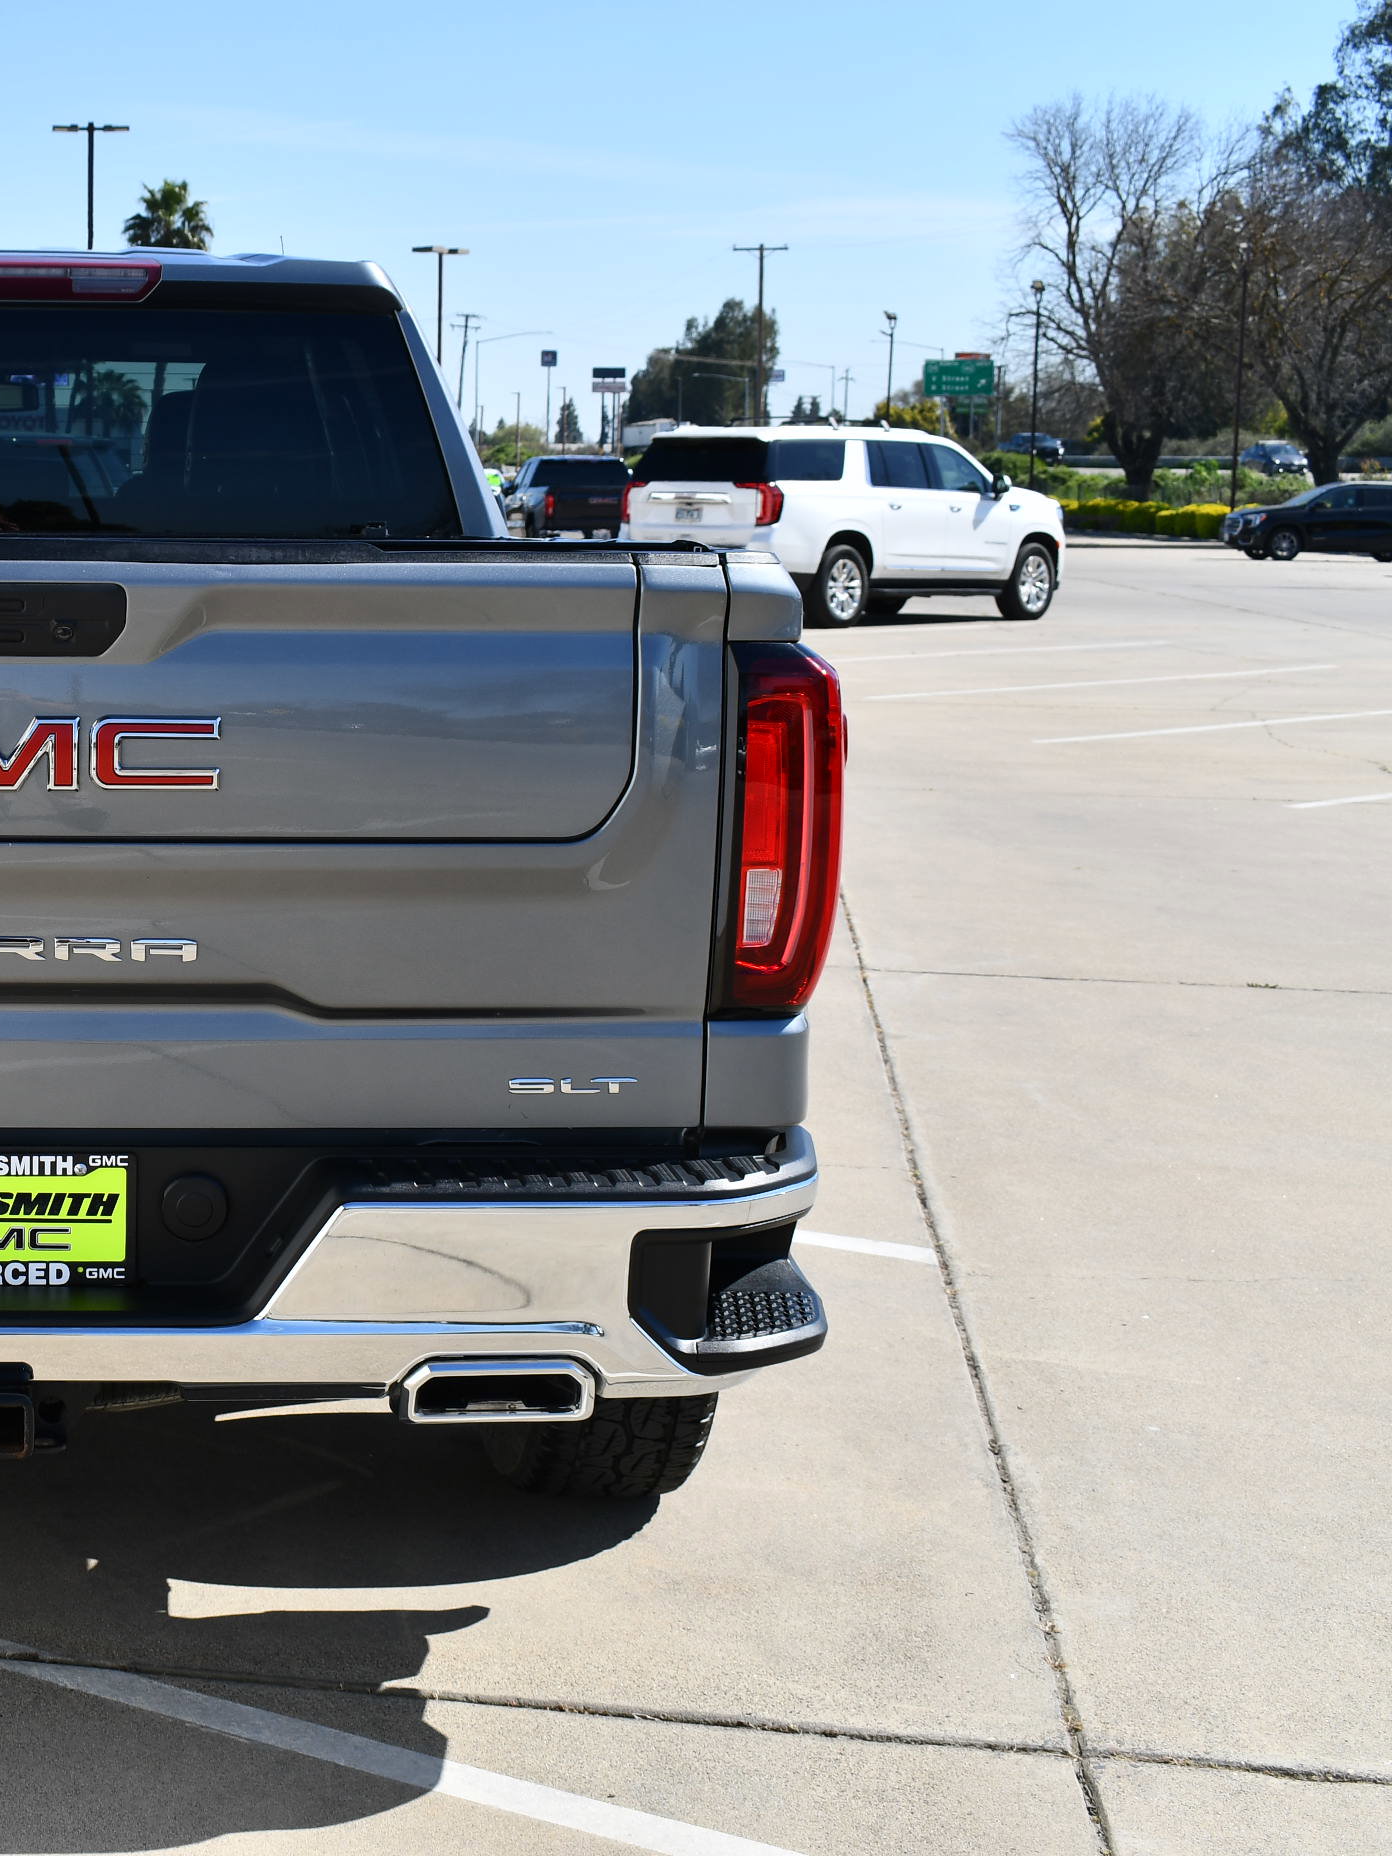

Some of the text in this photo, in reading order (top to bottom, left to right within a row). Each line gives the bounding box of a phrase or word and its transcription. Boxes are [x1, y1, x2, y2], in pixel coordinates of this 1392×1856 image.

[508, 1076, 639, 1094] SLT
[88, 1155, 129, 1167] GMC
[85, 1267, 126, 1279] GMC
